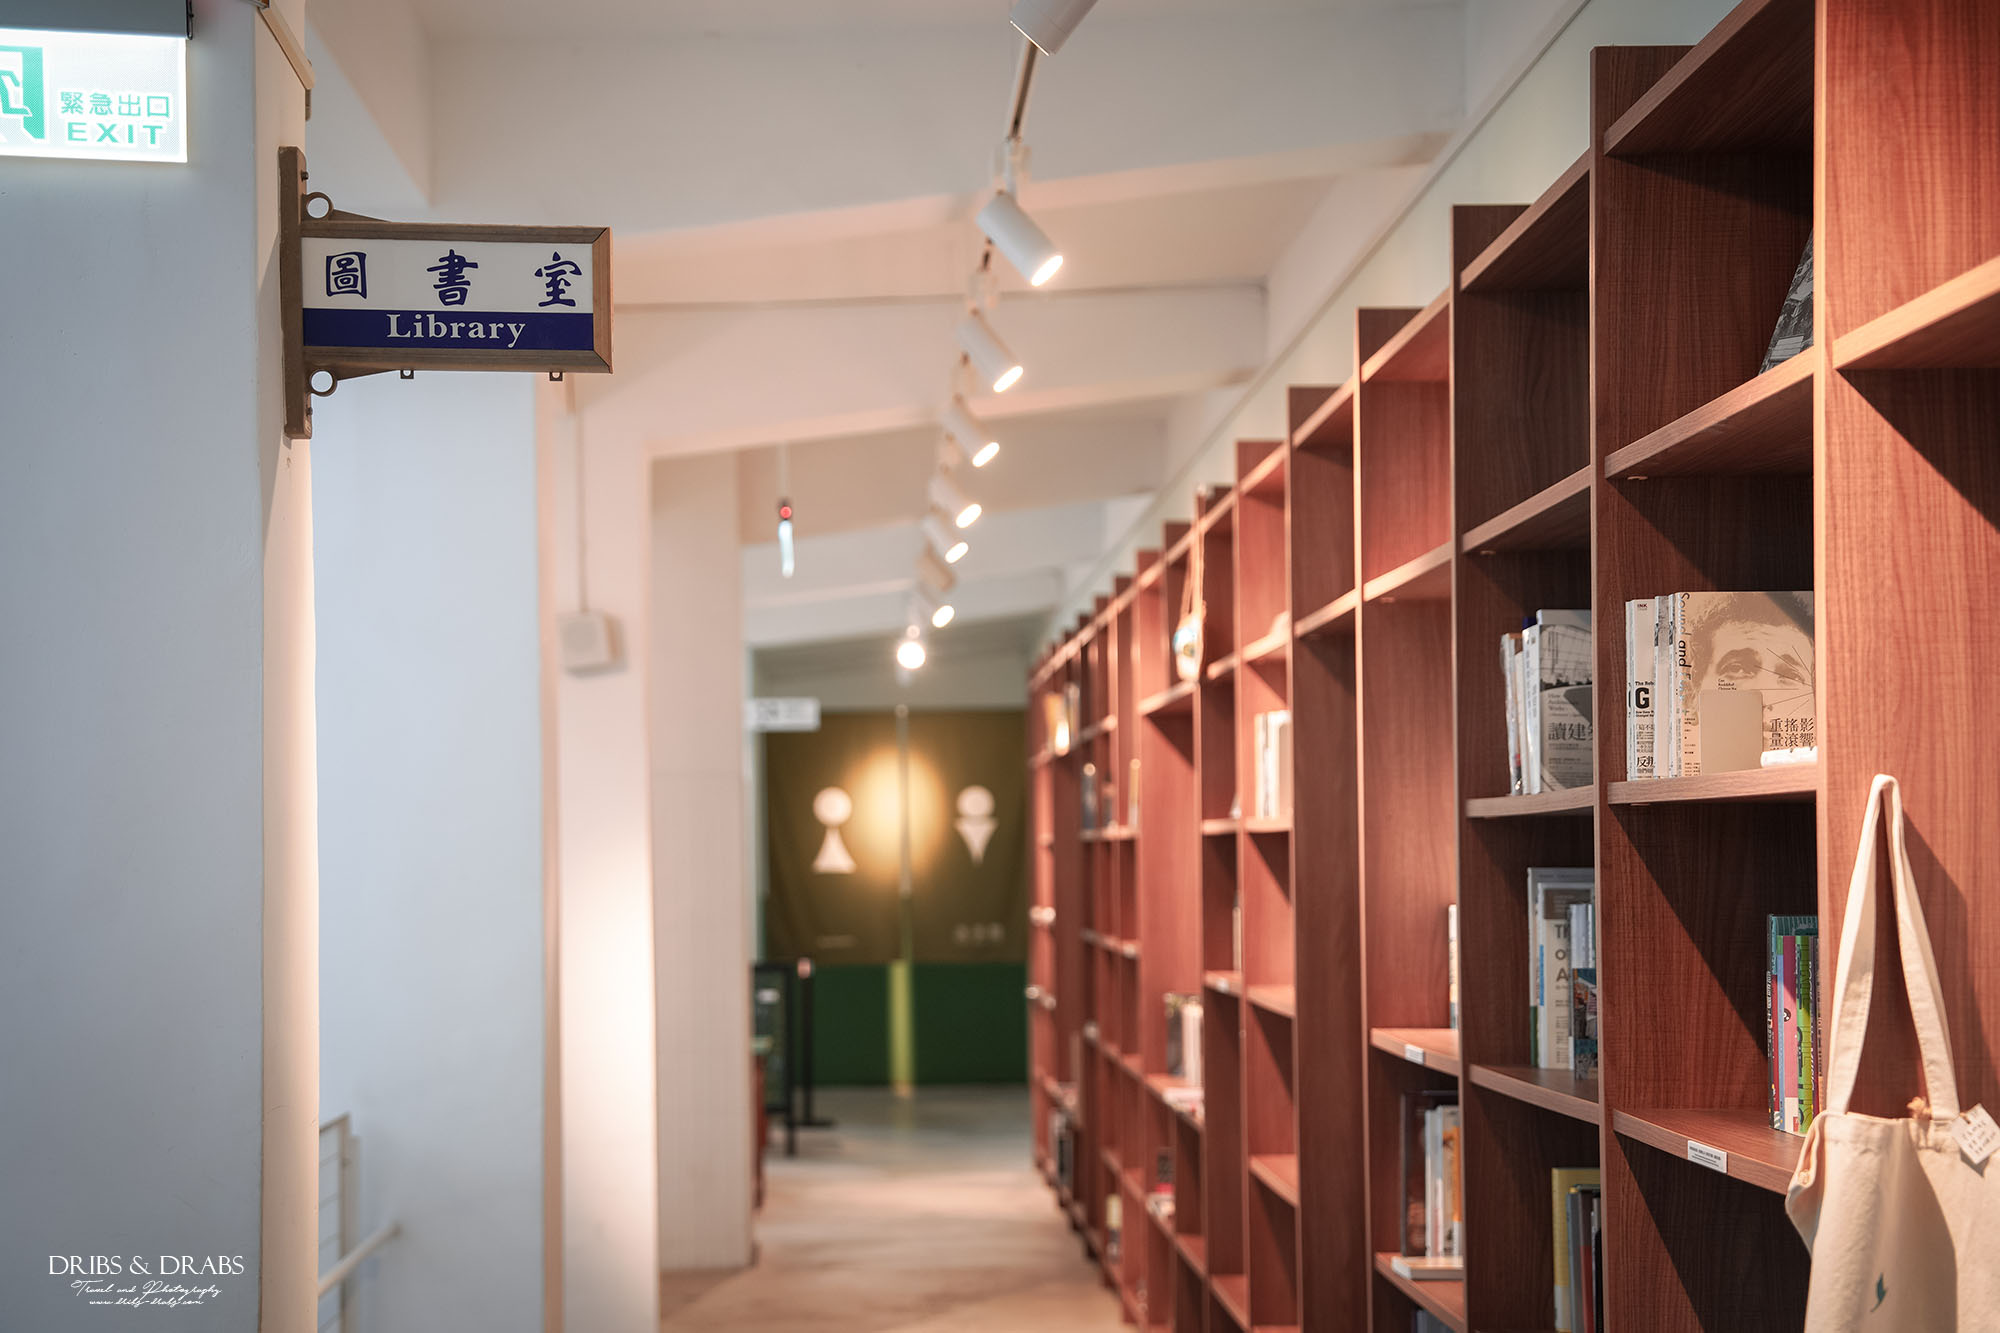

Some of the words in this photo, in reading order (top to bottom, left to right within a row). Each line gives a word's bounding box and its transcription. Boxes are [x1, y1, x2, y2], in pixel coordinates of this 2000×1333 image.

[61, 91, 170, 118] 緊急出口
[67, 122, 163, 145] EXIT
[325, 248, 583, 308] 圖書室
[386, 313, 526, 348] Library
[1678, 640, 1692, 667] and
